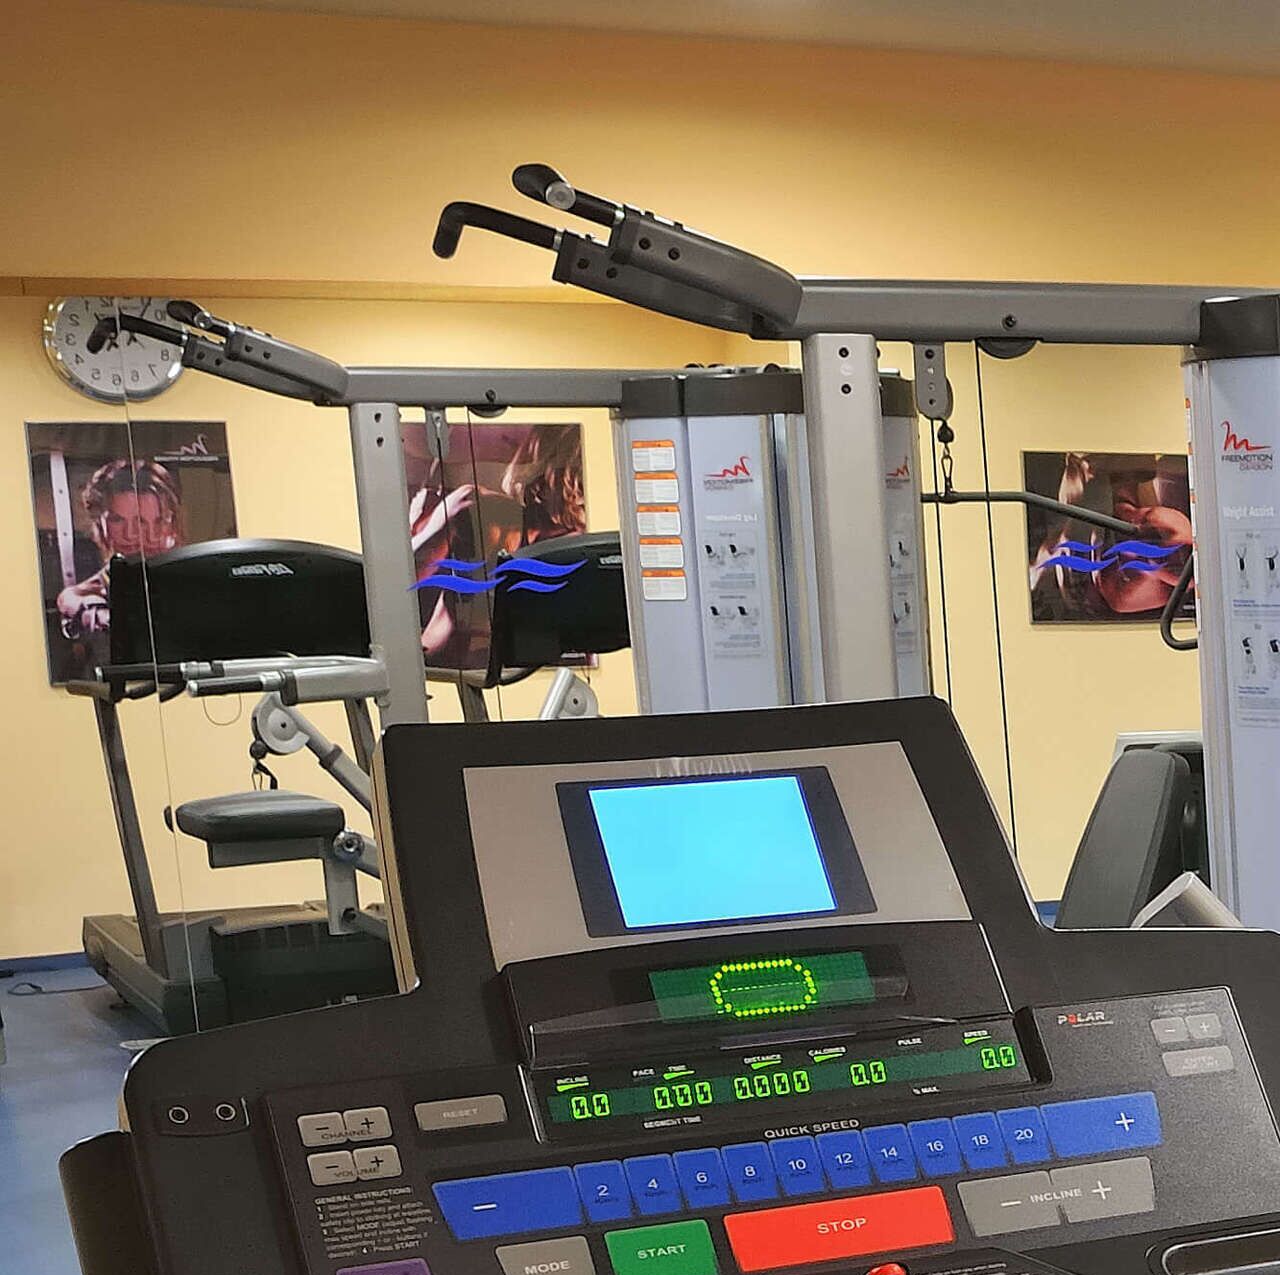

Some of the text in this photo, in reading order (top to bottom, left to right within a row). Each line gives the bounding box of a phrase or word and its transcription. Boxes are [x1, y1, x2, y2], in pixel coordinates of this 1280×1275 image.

[1057, 1011, 1105, 1025] POLAR
[442, 1107, 479, 1119] RESET
[321, 1128, 373, 1140] CHANNEL
[764, 1118, 860, 1139] QUICK SPEED
[1014, 1128, 1034, 1140] 20
[926, 1140, 944, 1152] 16
[972, 1134, 990, 1147] 18
[835, 1152, 854, 1165] 12
[881, 1146, 898, 1159] 14
[744, 1165, 756, 1177] 8
[788, 1159, 807, 1171] 10
[648, 1178, 658, 1189] 4
[696, 1172, 708, 1183] 6
[597, 1185, 609, 1196] 2
[1030, 1188, 1082, 1203] INCLINE
[817, 1218, 868, 1235] STOP
[637, 1244, 686, 1259] START
[524, 1260, 571, 1275] MODE
